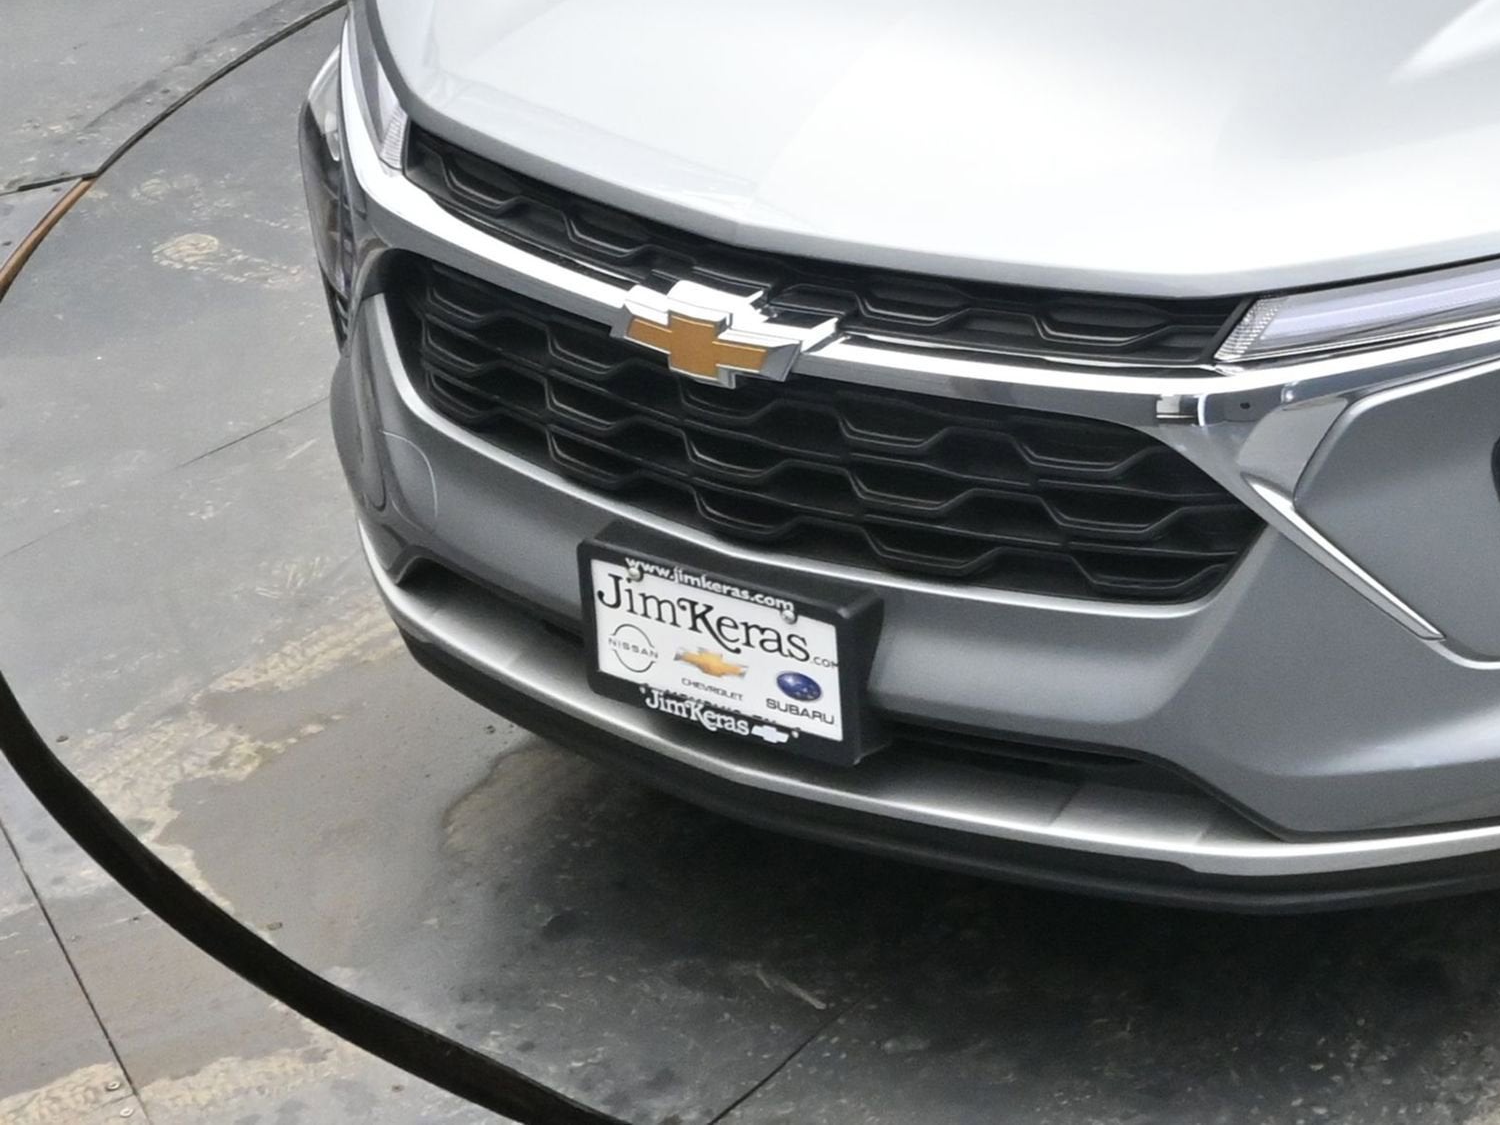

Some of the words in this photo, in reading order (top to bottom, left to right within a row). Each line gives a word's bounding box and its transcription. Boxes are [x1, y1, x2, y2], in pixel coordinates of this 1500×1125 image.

[625, 557, 795, 611] www.jimkeras.com
[608, 637, 658, 659] NISSAN
[681, 678, 744, 702] CHEVROLET
[766, 693, 834, 725] SUBARU
